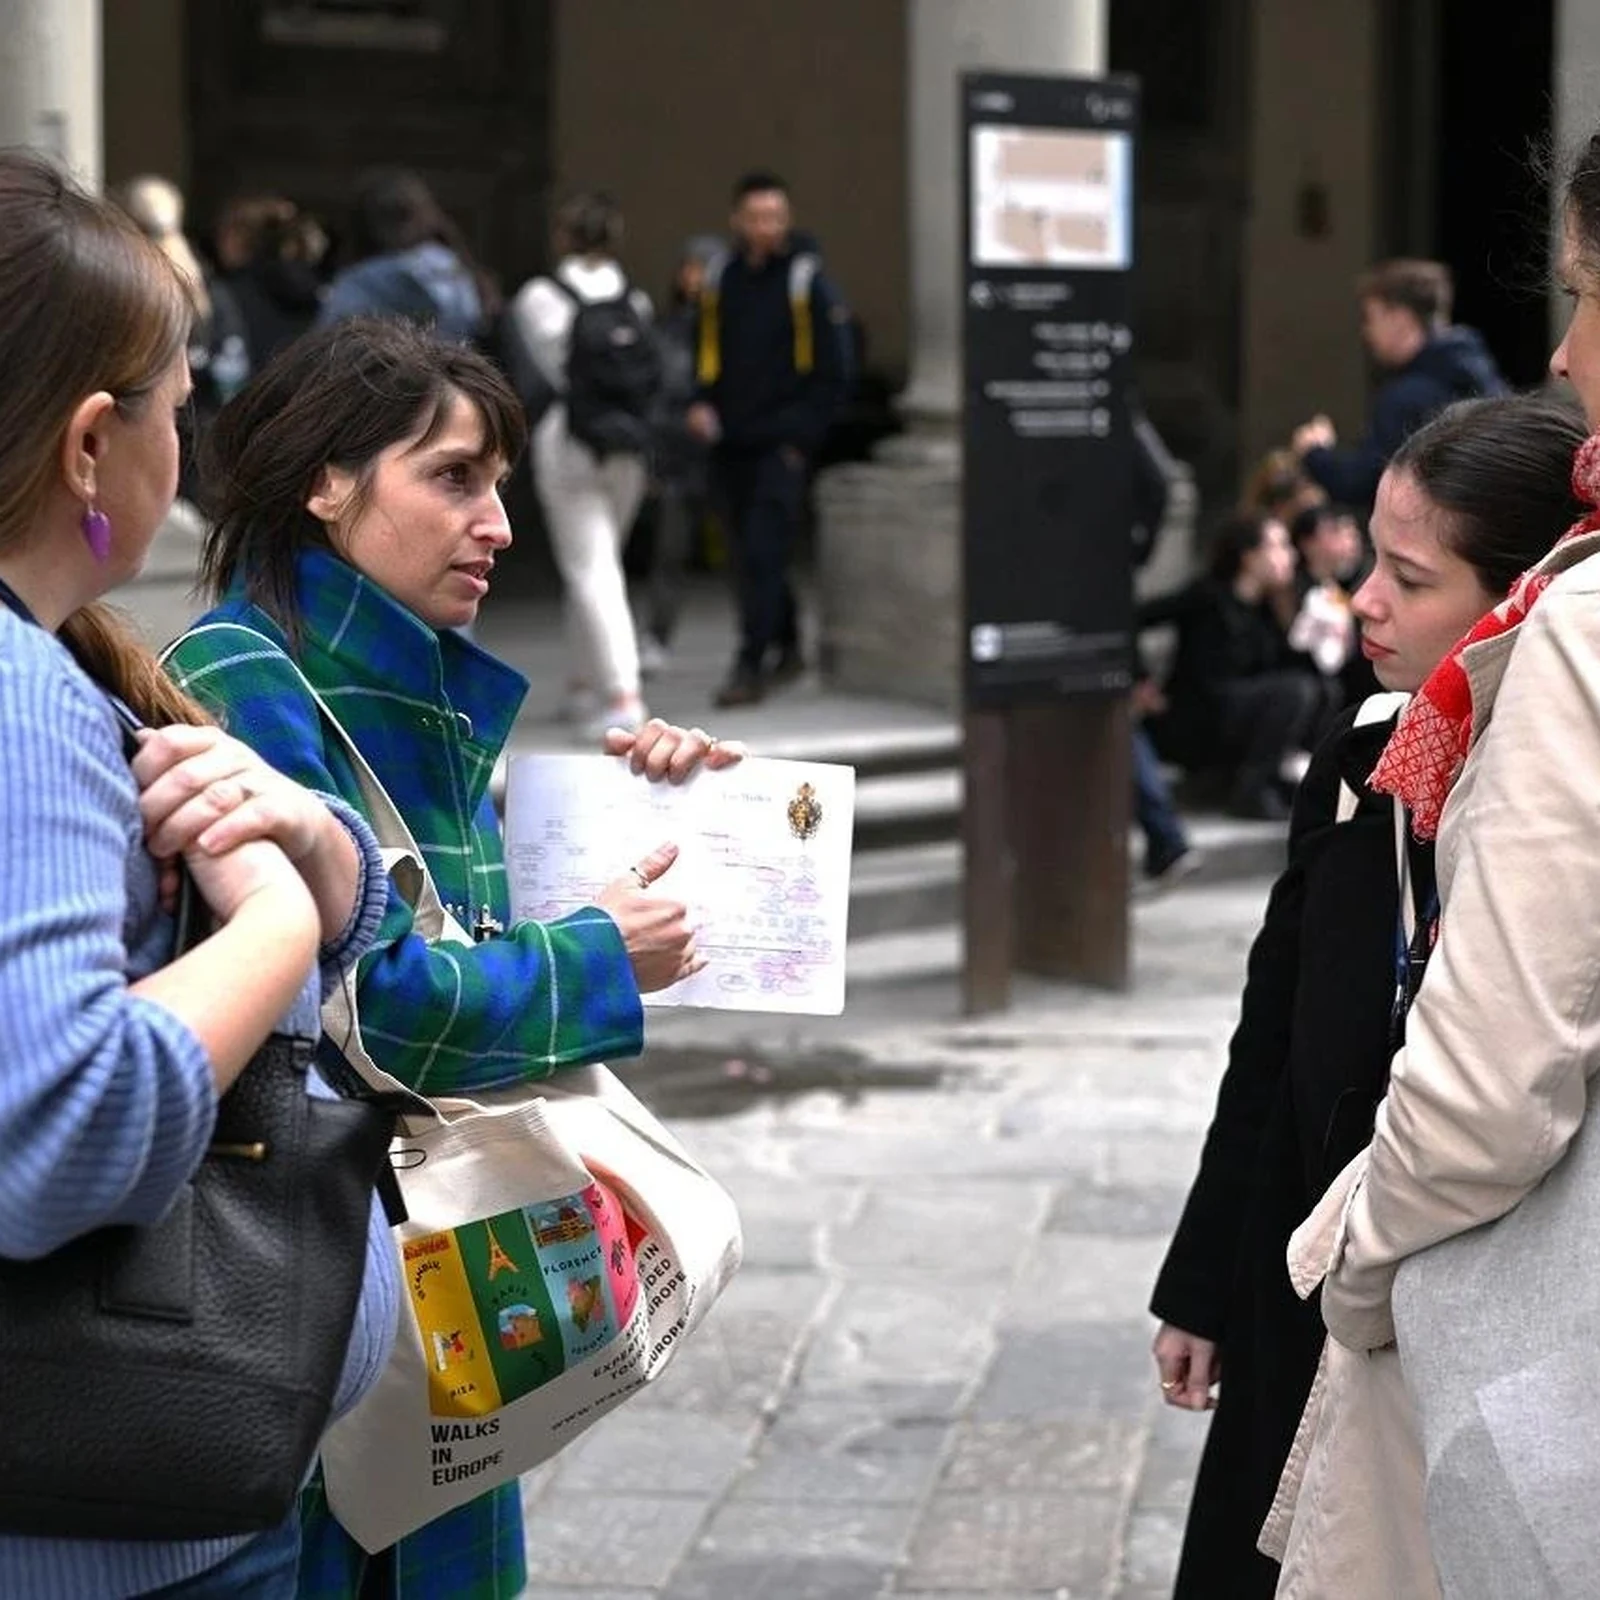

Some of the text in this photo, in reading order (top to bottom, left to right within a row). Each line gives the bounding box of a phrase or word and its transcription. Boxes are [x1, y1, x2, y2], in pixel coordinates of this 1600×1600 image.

[643, 1242, 660, 1262] IN
[450, 1383, 476, 1399] PISA
[431, 1418, 500, 1443] WALKS
[432, 1448, 452, 1465] IN
[432, 1450, 504, 1487] EUROPE
